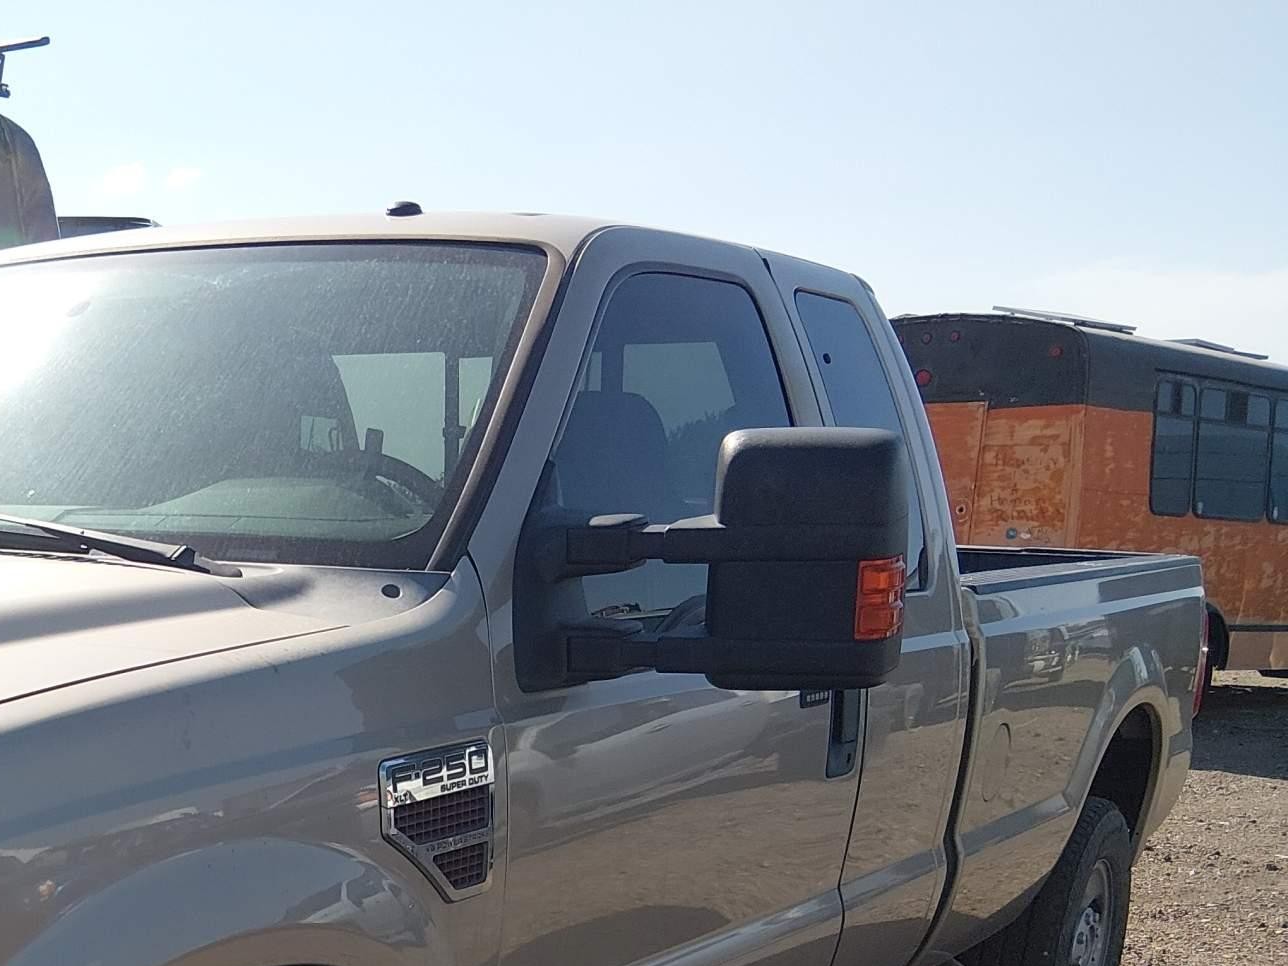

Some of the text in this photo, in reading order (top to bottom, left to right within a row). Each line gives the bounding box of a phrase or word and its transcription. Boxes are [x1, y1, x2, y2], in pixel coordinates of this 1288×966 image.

[391, 748, 489, 793] F-250
[440, 774, 489, 793] SUPER DUTY
